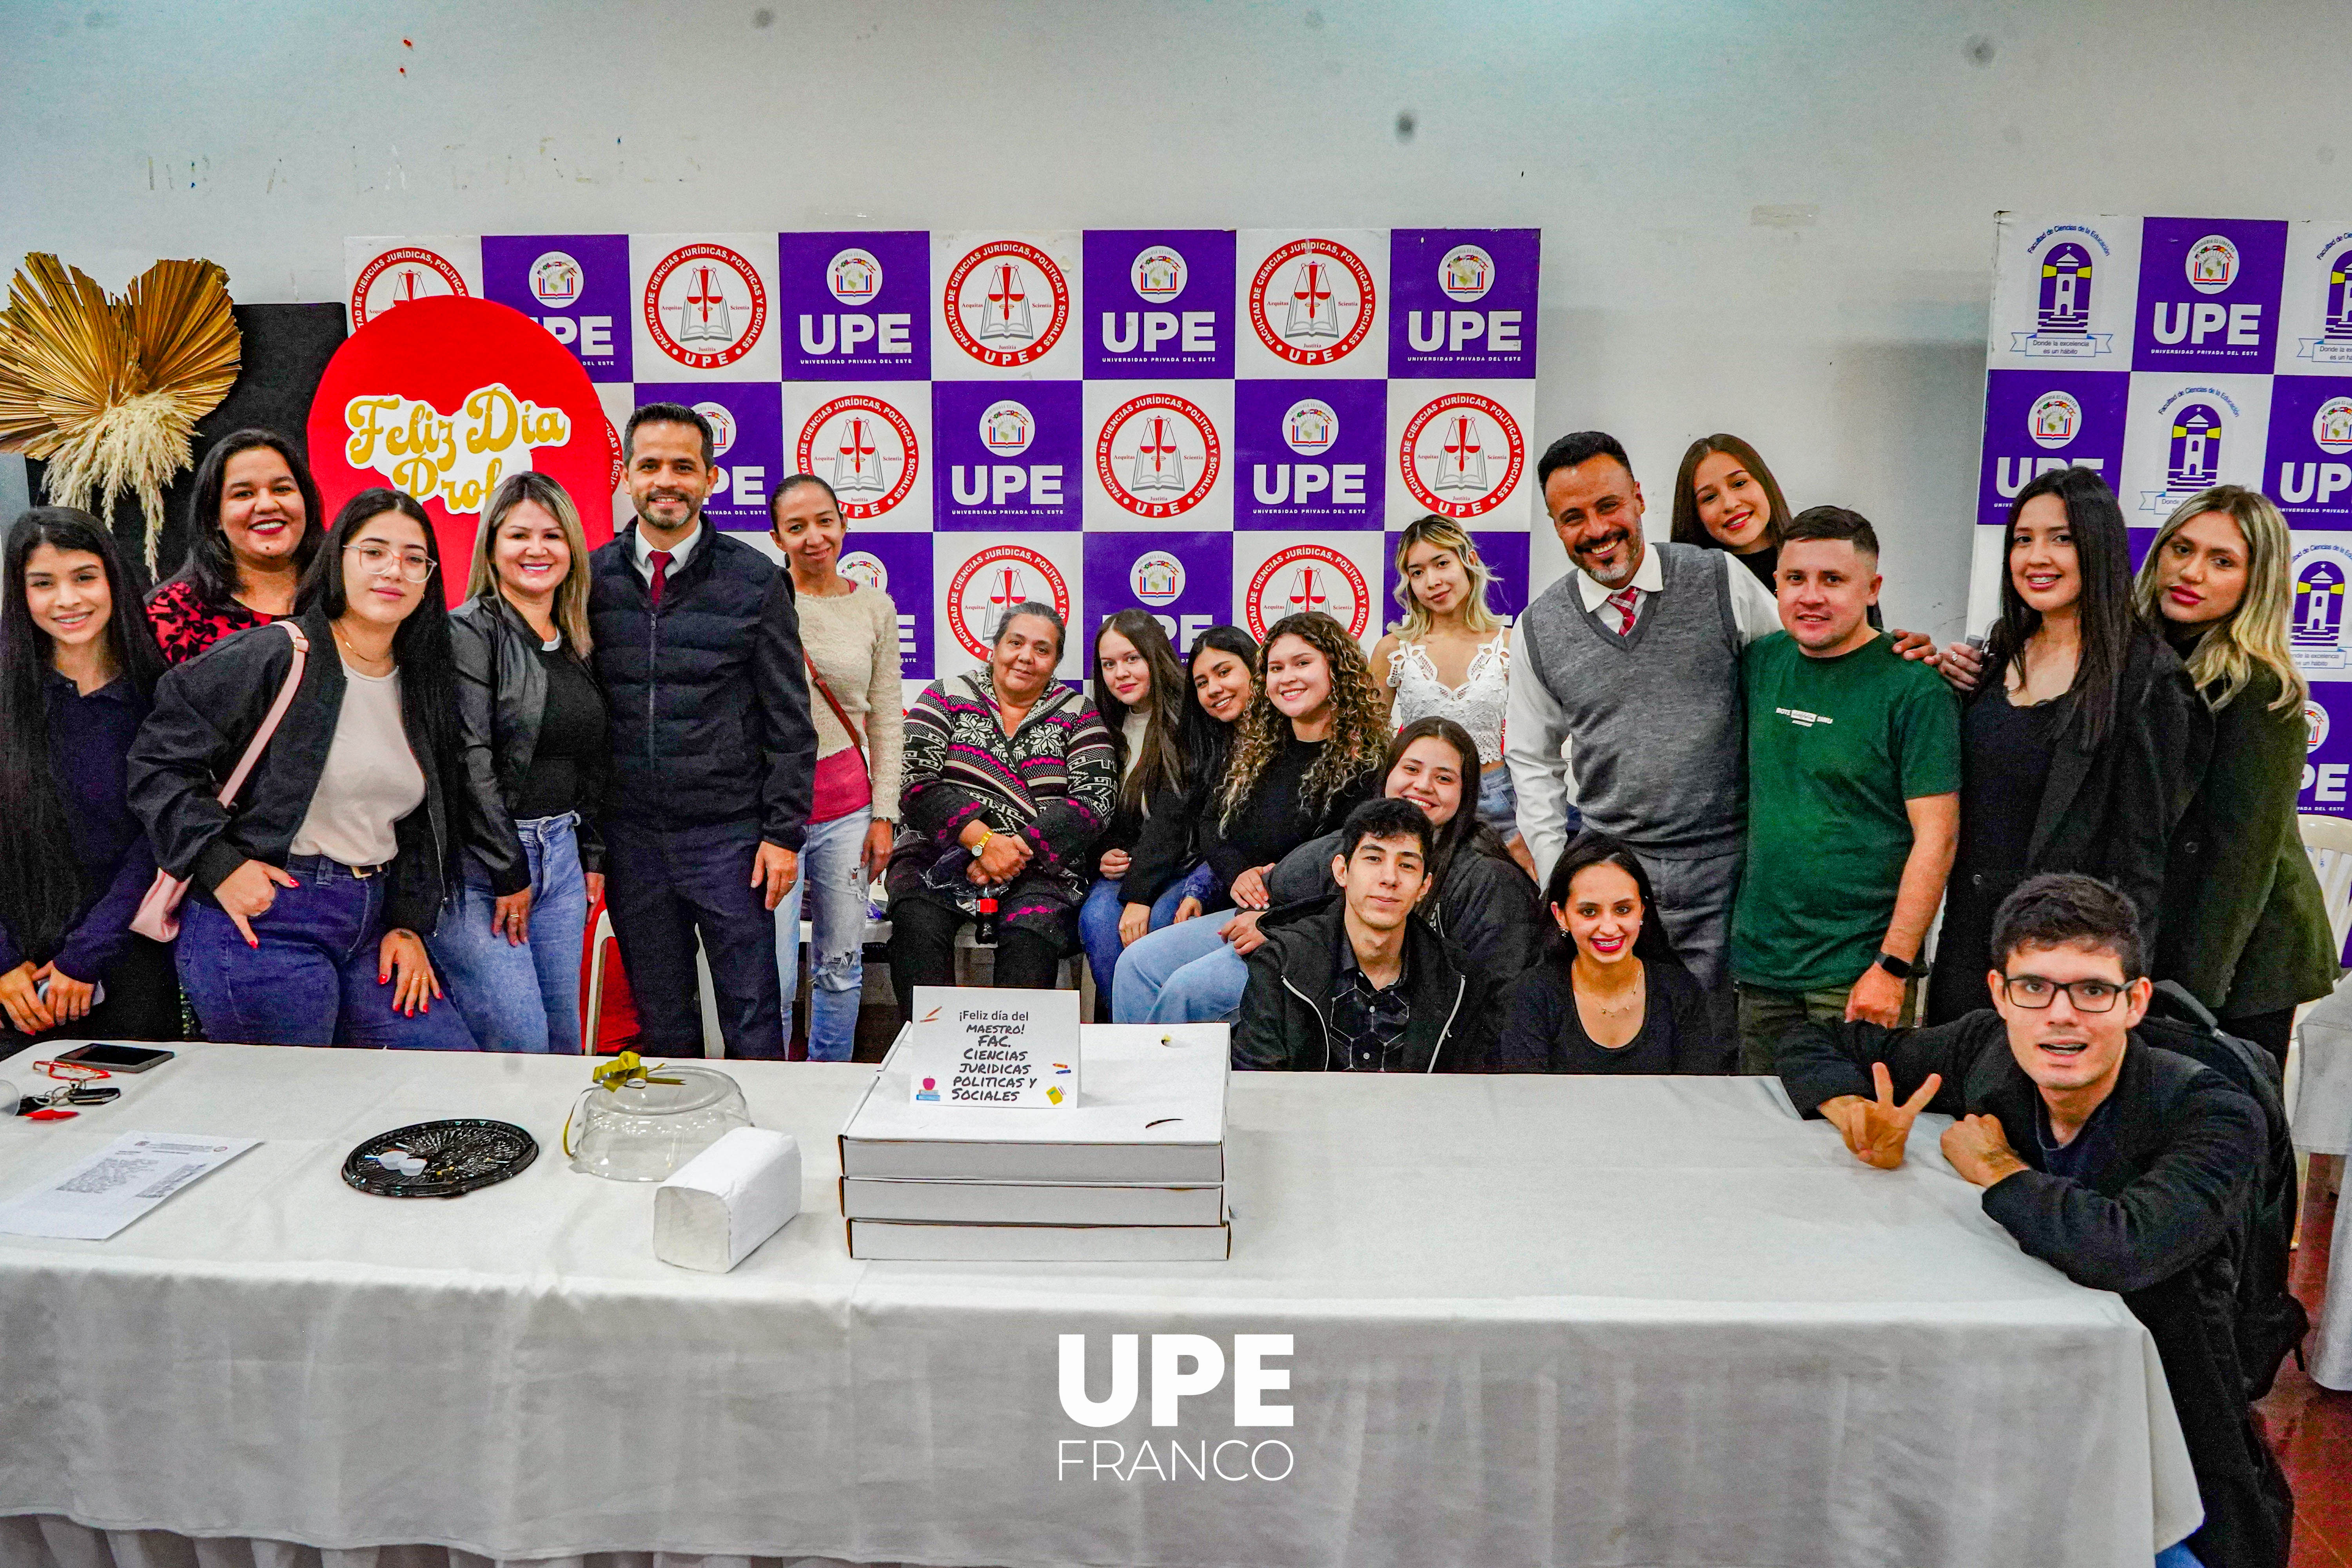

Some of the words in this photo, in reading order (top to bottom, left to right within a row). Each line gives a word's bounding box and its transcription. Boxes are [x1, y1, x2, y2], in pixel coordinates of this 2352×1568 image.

[2027, 232, 2046, 254] Facultad
[650, 255, 679, 290] CIENCIAS
[730, 255, 762, 296] POLÍTICAS
[951, 252, 981, 287] CIENCIAS
[1033, 252, 1064, 293] POLÍTICAS
[1257, 250, 1287, 285] CIENCIAS
[1340, 251, 1371, 292] POLÍTICAS
[648, 292, 655, 304] DE
[947, 289, 956, 301] DE
[1253, 287, 1261, 299] DE
[529, 316, 614, 356] PE
[648, 307, 671, 349] FACULTAD
[742, 307, 764, 348] SOCIALES
[800, 314, 912, 354] UPE
[947, 304, 970, 347] FACULTAD
[1043, 305, 1066, 346] SOCIALES
[1103, 312, 1216, 352] UPE
[1252, 302, 1275, 345] FACULTAD
[1348, 303, 1372, 345] SOCIALES
[1409, 311, 1522, 352] UPE
[2153, 302, 2262, 345] UPE
[684, 352, 728, 367] UPE
[984, 350, 1029, 365] UPE
[1289, 348, 1334, 363] UPE
[349, 397, 457, 472] Feliz
[467, 386, 566, 454] Día
[803, 406, 832, 441] CIENCIAS
[883, 407, 914, 447] POLÍTICAS
[1103, 405, 1134, 439] CIENCIAS
[1185, 405, 1216, 446] POLÍTICAS
[1407, 404, 1438, 439] CIENCIAS
[1490, 405, 1520, 446] POLÍTICAS
[800, 442, 808, 455] DE
[1100, 441, 1108, 453] DE
[1403, 440, 1412, 452] DE
[894, 458, 916, 499] SOCIALES
[952, 465, 1063, 505] UPE
[1099, 456, 1122, 499] FACULTAD
[1194, 457, 1217, 498] SOCIALES
[1254, 465, 1366, 505] UPE
[1403, 455, 1425, 498] FACULTAD
[1497, 457, 1521, 498] SOCIALES
[2280, 462, 2352, 503] UP
[1136, 501, 1180, 516] UPE
[1438, 501, 1482, 516] UPE
[954, 556, 984, 590] CIENCIAS
[1034, 557, 1065, 597] POLÍTICAS
[1253, 555, 1283, 590] CIENCIAS
[1335, 556, 1365, 596] POLÍTICAS
[951, 592, 959, 603] DE
[1249, 591, 1258, 603] DE
[950, 606, 973, 648] FACULTAD
[960, 1010, 988, 1022] ¡Feliz
[991, 1010, 1008, 1020] día
[1012, 1011, 1028, 1021] del
[966, 1024, 1025, 1034] MAESTRO!
[964, 1048, 1028, 1061] CIENCIAS
[978, 1034, 1011, 1047] FAC.
[953, 1076, 1025, 1088] POLITICAS
[1030, 1078, 1037, 1088] Y
[959, 1063, 1031, 1074] JURIDICAS
[952, 1088, 1020, 1101] SOCIALES
